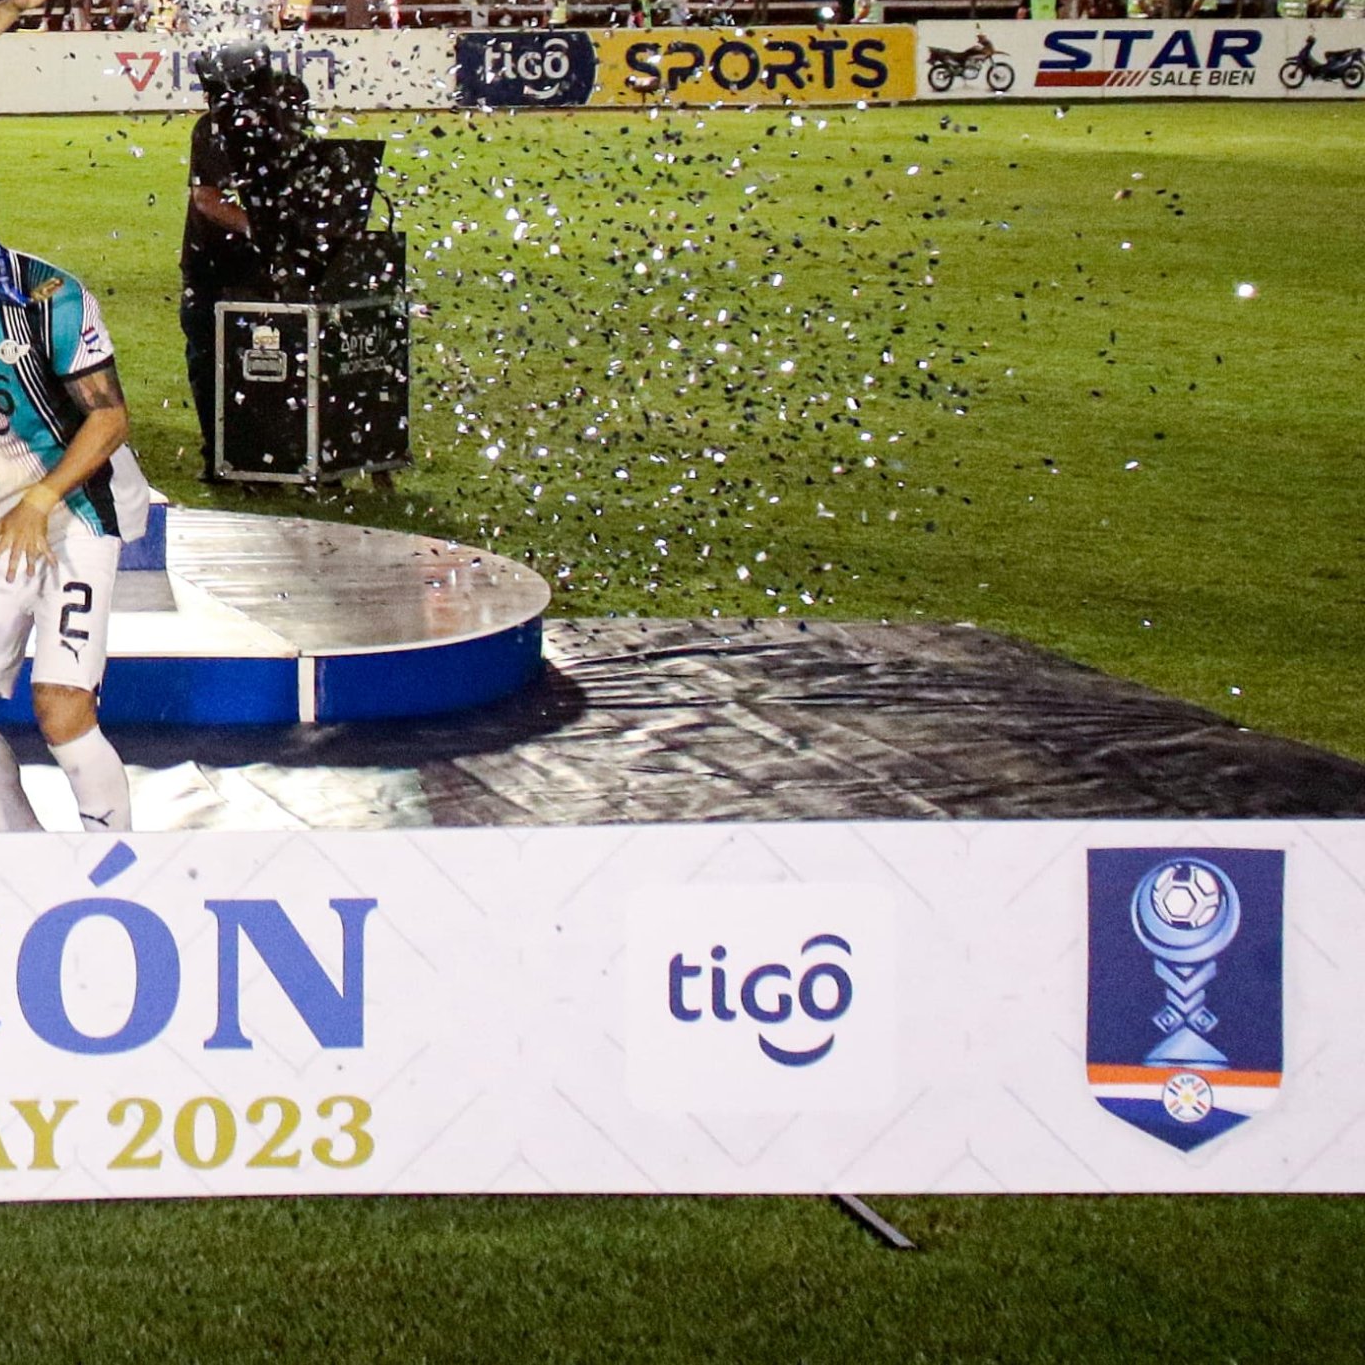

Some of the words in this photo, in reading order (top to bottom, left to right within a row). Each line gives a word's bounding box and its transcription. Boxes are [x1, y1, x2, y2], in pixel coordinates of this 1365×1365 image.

[625, 39, 889, 93] SPORTS
[1039, 29, 1263, 69] STAR
[1149, 71, 1203, 87] SALE
[1207, 69, 1257, 87] BIEN
[60, 581, 92, 640] 2
[105, 1094, 377, 1172] 2023
